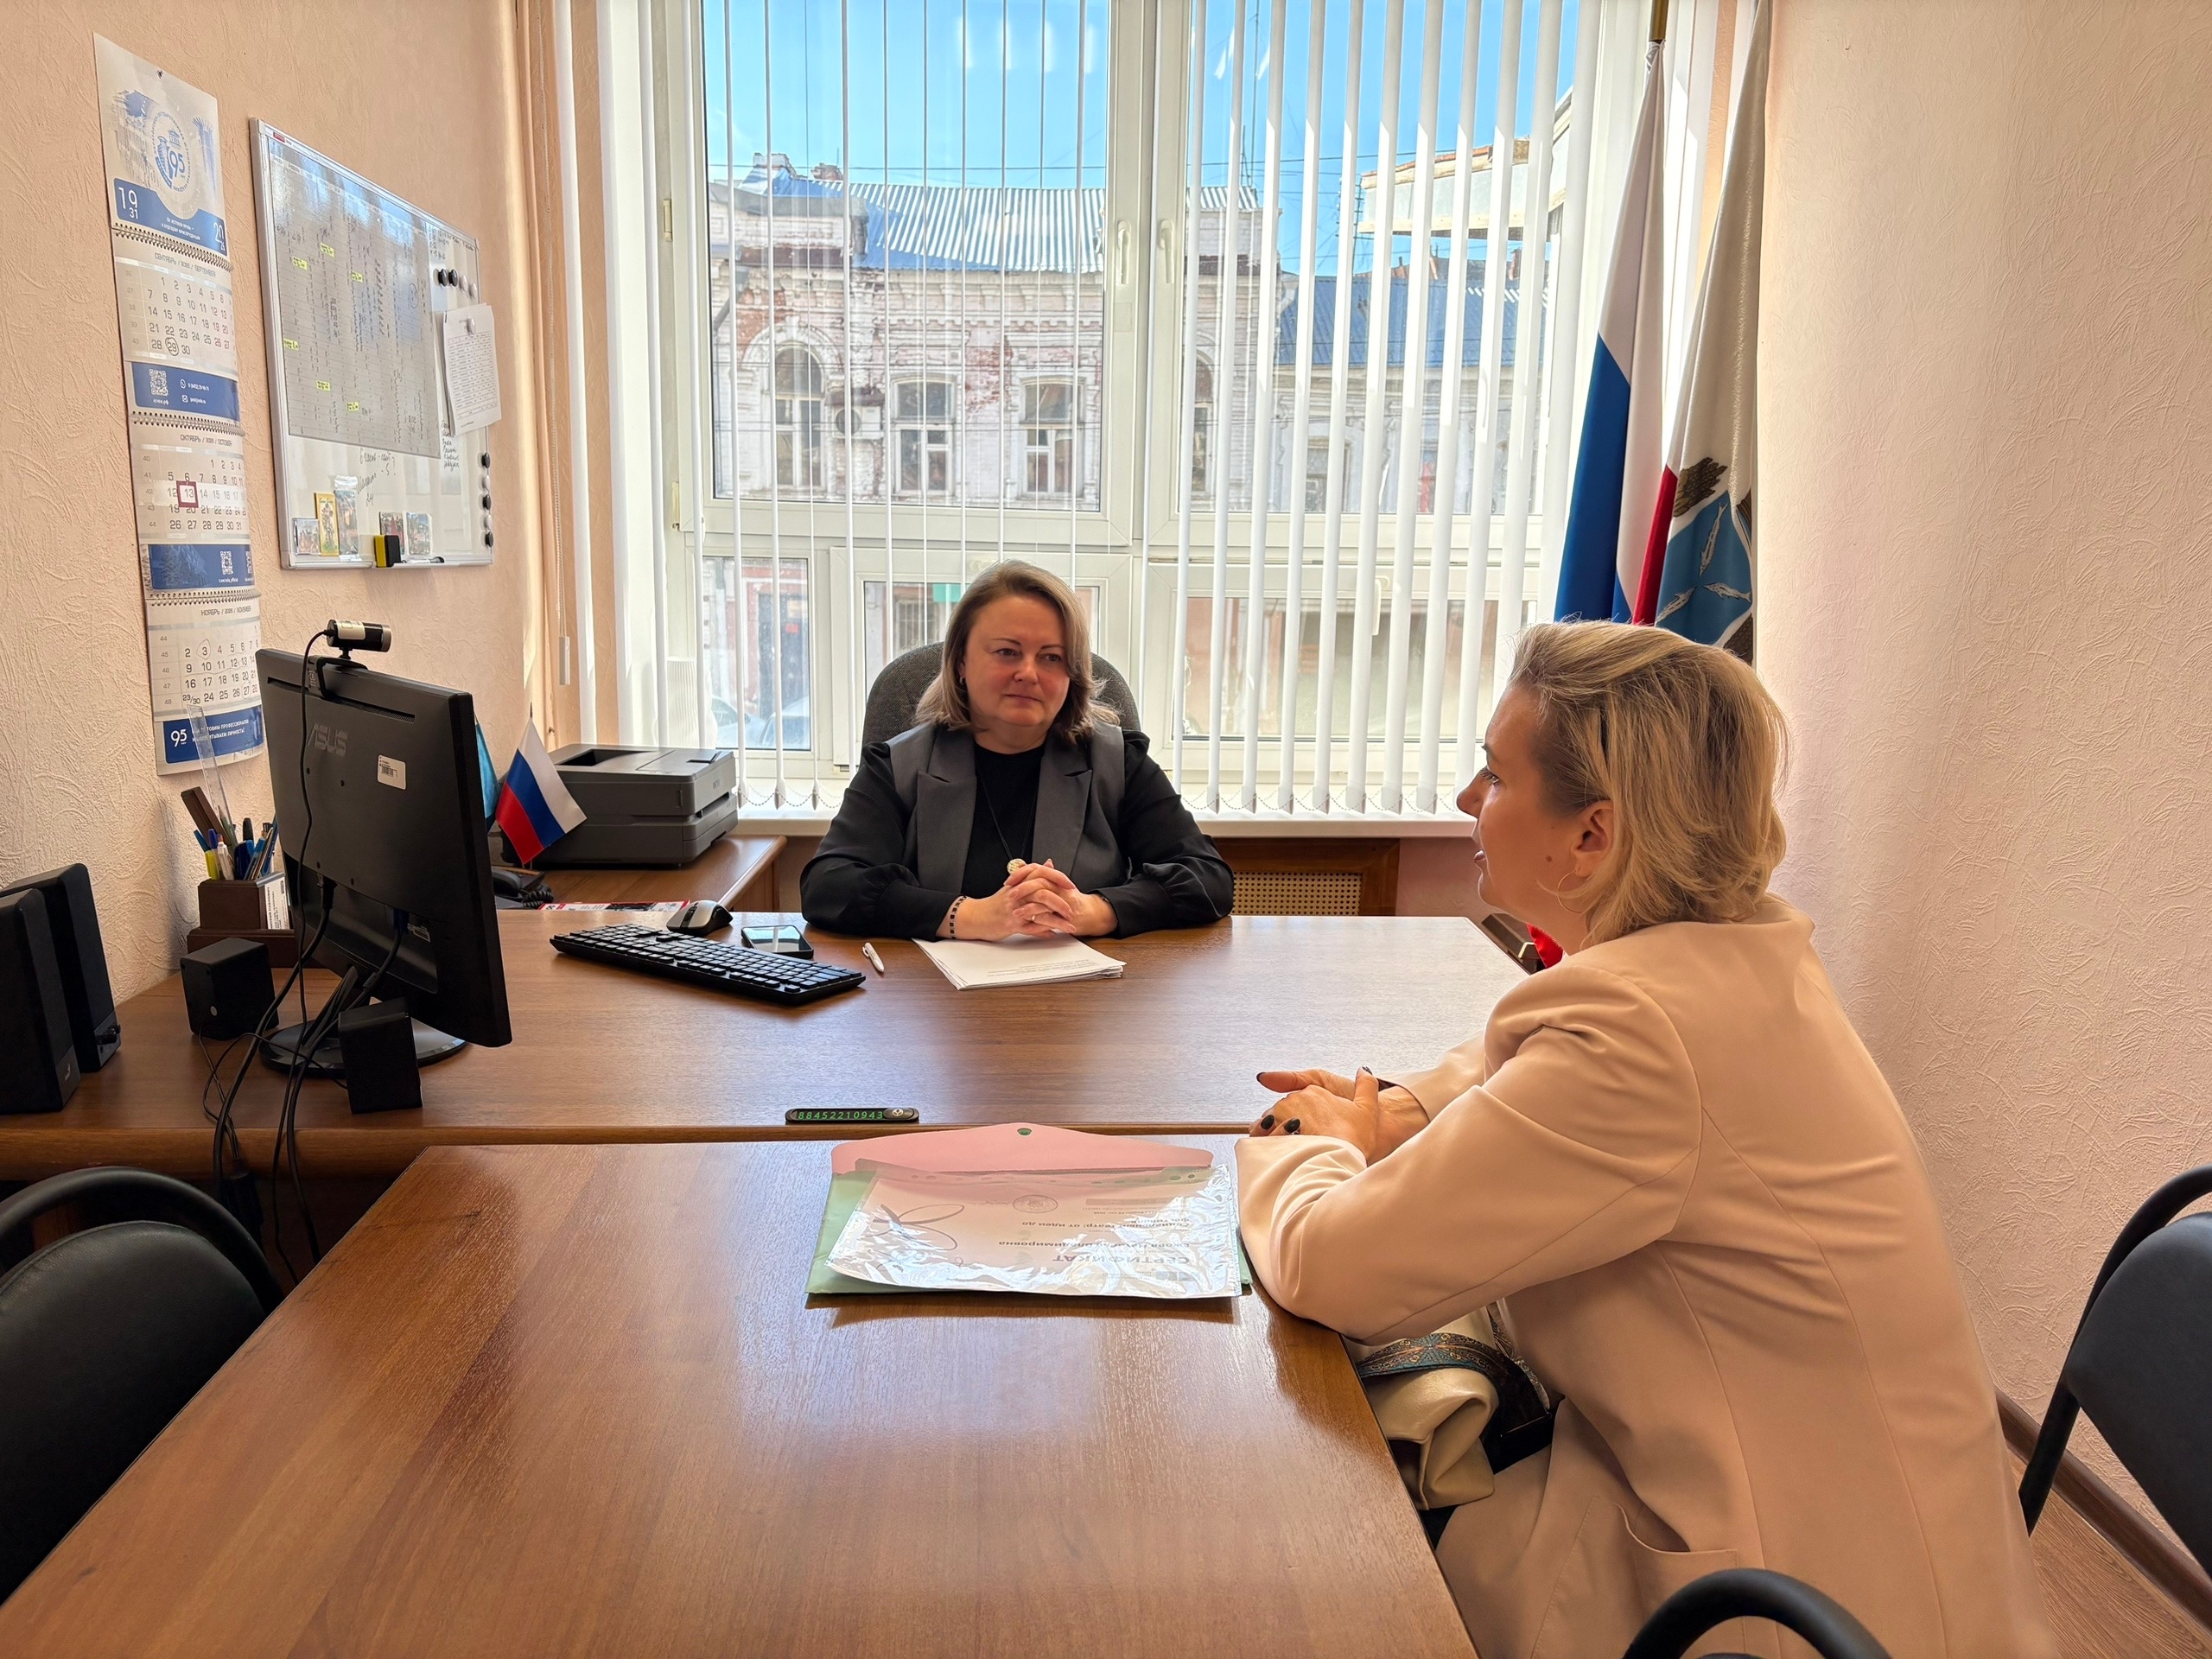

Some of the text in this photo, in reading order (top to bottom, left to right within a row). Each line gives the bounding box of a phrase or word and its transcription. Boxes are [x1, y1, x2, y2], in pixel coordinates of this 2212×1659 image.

[169, 150, 185, 178] 95
[118, 187, 137, 209] 19
[130, 207, 138, 219] 31
[175, 281, 179, 289] 2
[187, 284, 192, 294] 3
[200, 288, 203, 296] 4
[210, 291, 214, 300] 5
[220, 295, 224, 303] 6
[148, 289, 153, 299] 7
[163, 293, 168, 302] 8
[176, 297, 181, 306] 9
[188, 300, 195, 310] 10
[200, 303, 207, 313] 11
[211, 306, 218, 316] 12
[221, 309, 226, 320] 13
[149, 306, 157, 316] 14
[163, 309, 172, 320] 15
[177, 313, 186, 322] 16
[190, 315, 197, 326] 17
[202, 319, 209, 328] 18
[213, 321, 219, 332] 19
[222, 325, 228, 334] 20
[149, 322, 159, 333] 21
[165, 326, 175, 336] 22
[179, 329, 188, 339] 23
[192, 332, 200, 341] 24
[203, 334, 212, 345] 25
[151, 340, 162, 350] 28
[167, 342, 176, 353] 29
[181, 345, 190, 354] 30
[180, 434, 201, 443] ОКТЯБРЬ
[218, 438, 232, 447] OCTOBER
[211, 459, 213, 467] 1
[221, 461, 226, 469] 2
[231, 461, 234, 470] 3
[168, 472, 174, 480] 5
[185, 473, 190, 481] 6
[199, 474, 204, 483] 7
[213, 475, 216, 484] 8
[185, 489, 194, 498] 13
[200, 489, 207, 499] 14
[213, 491, 220, 499] 15
[201, 505, 209, 514] 21
[169, 520, 181, 530] 26
[188, 520, 196, 530] 27
[202, 521, 211, 530] 28
[216, 521, 223, 531] 29
[226, 522, 233, 531] 30
[237, 522, 242, 531] 31
[185, 649, 191, 658] 2
[218, 645, 222, 654] 4
[231, 644, 234, 652] 5
[241, 642, 245, 651] 6
[187, 664, 192, 673] 9
[202, 662, 212, 671] 10
[218, 660, 226, 670] 11
[231, 658, 238, 668] 12
[241, 657, 247, 665] 13
[186, 679, 196, 689] 16
[203, 677, 212, 686] 17
[219, 676, 227, 684] 18
[232, 673, 239, 682] 19
[242, 671, 249, 681] 20
[251, 670, 256, 679] 21
[204, 693, 214, 702] 24
[219, 690, 228, 700] 25
[233, 689, 240, 697] 26
[244, 687, 250, 696] 27
[170, 728, 188, 747] 95
[307, 722, 347, 757] ASUS
[798, 1111, 883, 1121] 88452210943
[1052, 1255, 1190, 1264] СЕРТИФИКАТ
